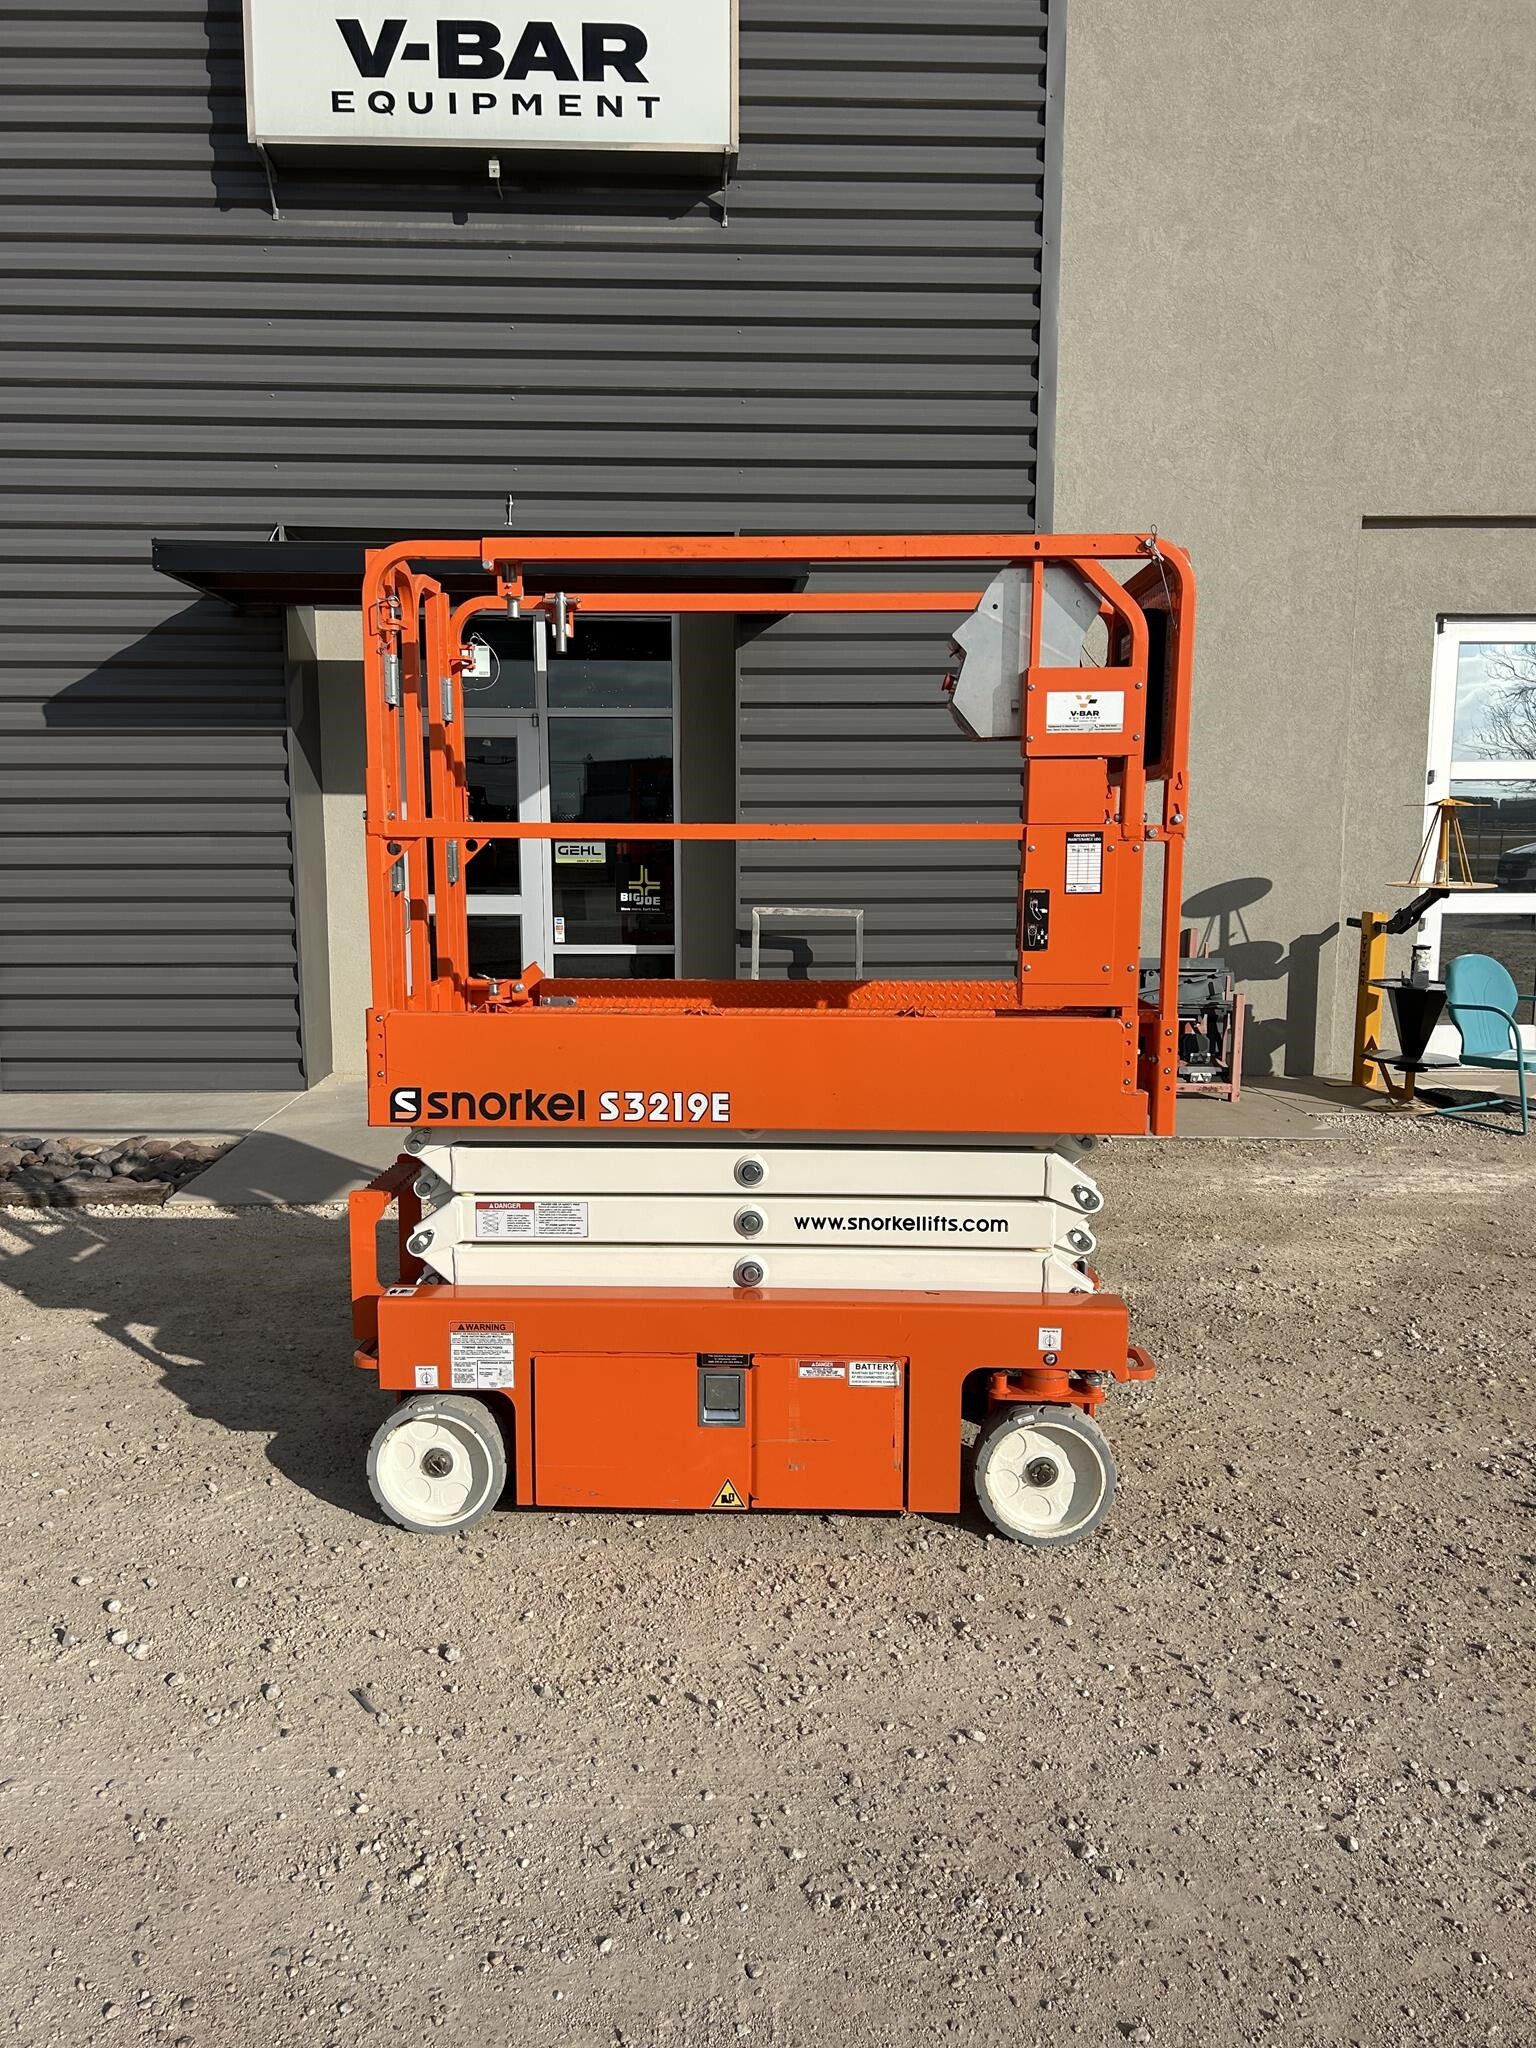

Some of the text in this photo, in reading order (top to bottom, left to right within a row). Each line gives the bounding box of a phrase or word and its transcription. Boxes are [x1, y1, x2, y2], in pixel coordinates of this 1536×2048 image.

[335, 18, 650, 84] V-BAR
[331, 90, 661, 119] EQUIPMENT
[557, 845, 602, 856] GEHL
[620, 892, 641, 902] BIG
[636, 896, 661, 905] JOE
[427, 1088, 585, 1122] snorkel
[599, 1091, 731, 1123] S3219E
[794, 1215, 1009, 1233] www.snorkellifts.com
[465, 1323, 506, 1331] WARNING
[855, 1363, 894, 1371] BATTERY
